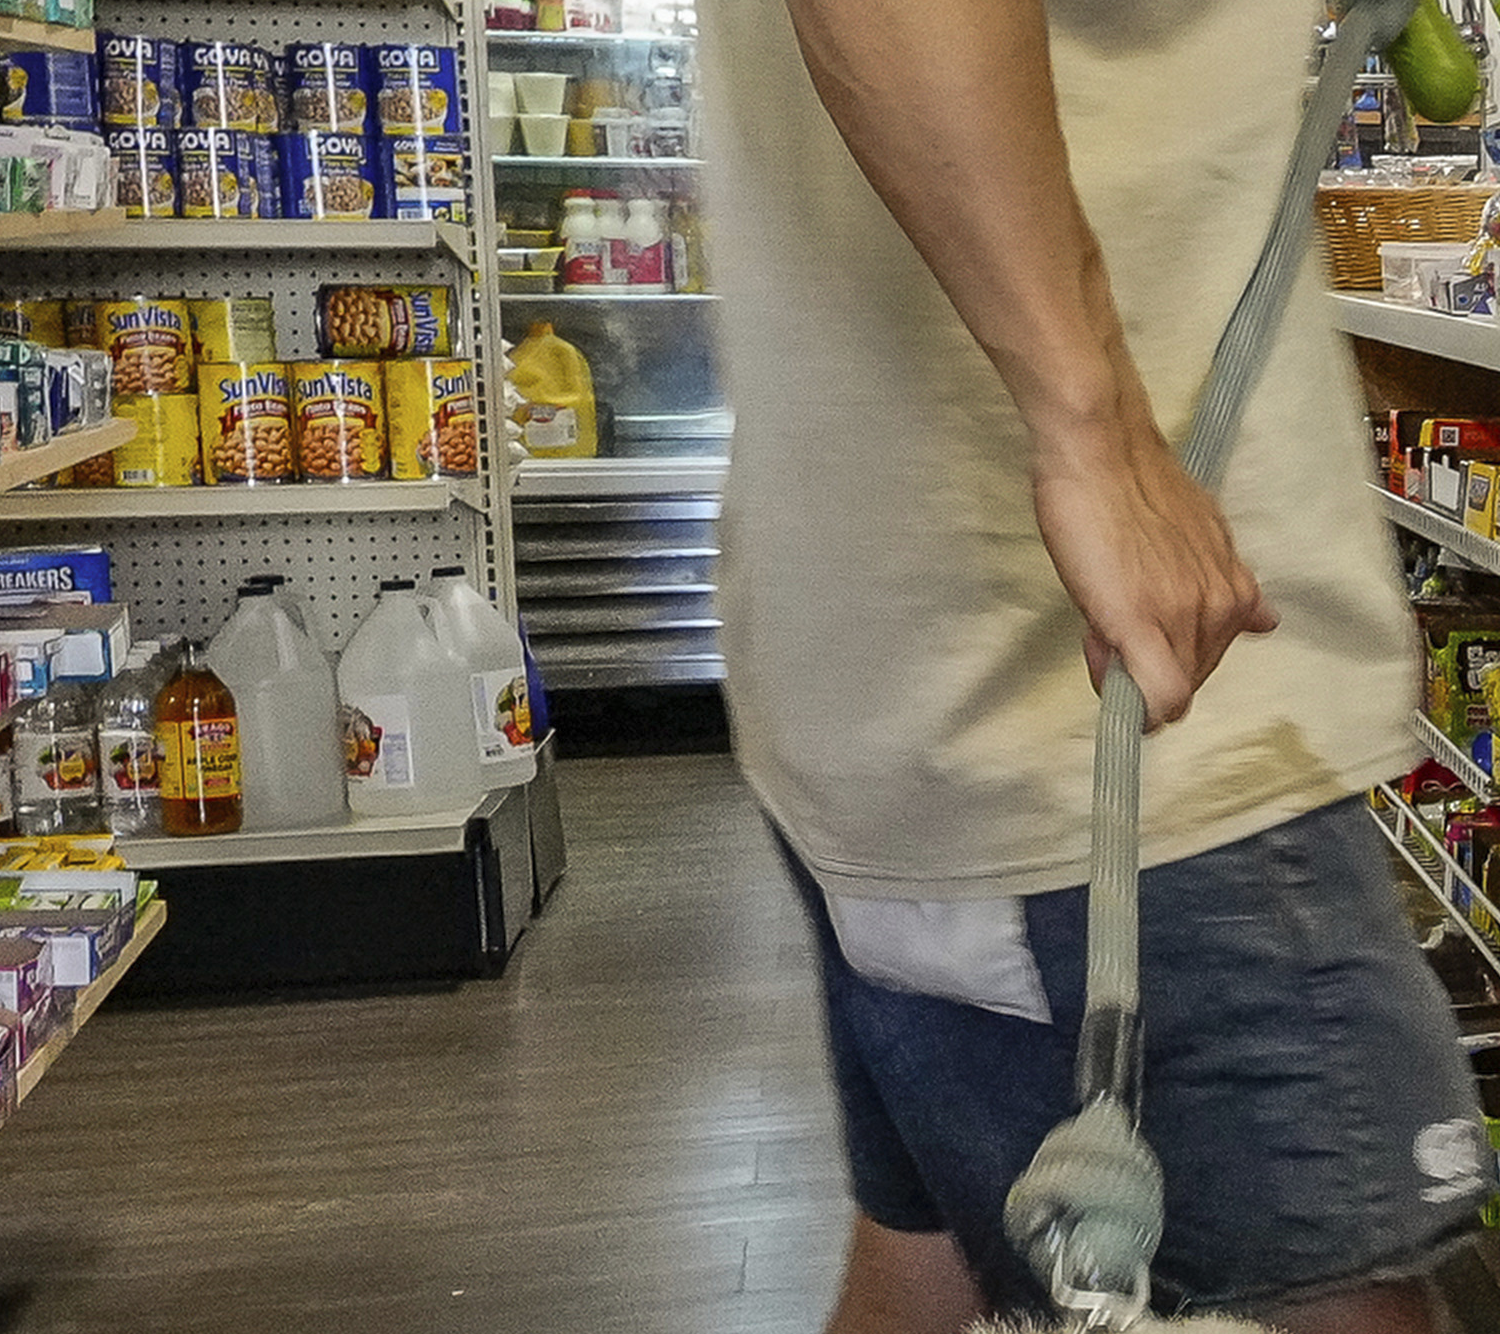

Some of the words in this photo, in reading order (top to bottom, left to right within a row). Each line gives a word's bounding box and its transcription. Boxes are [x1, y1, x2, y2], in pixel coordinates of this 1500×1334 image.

[295, 48, 356, 67] GOYA
[378, 48, 436, 67] GOYA
[108, 130, 168, 150] GOYA
[218, 376, 287, 402] SunVis
